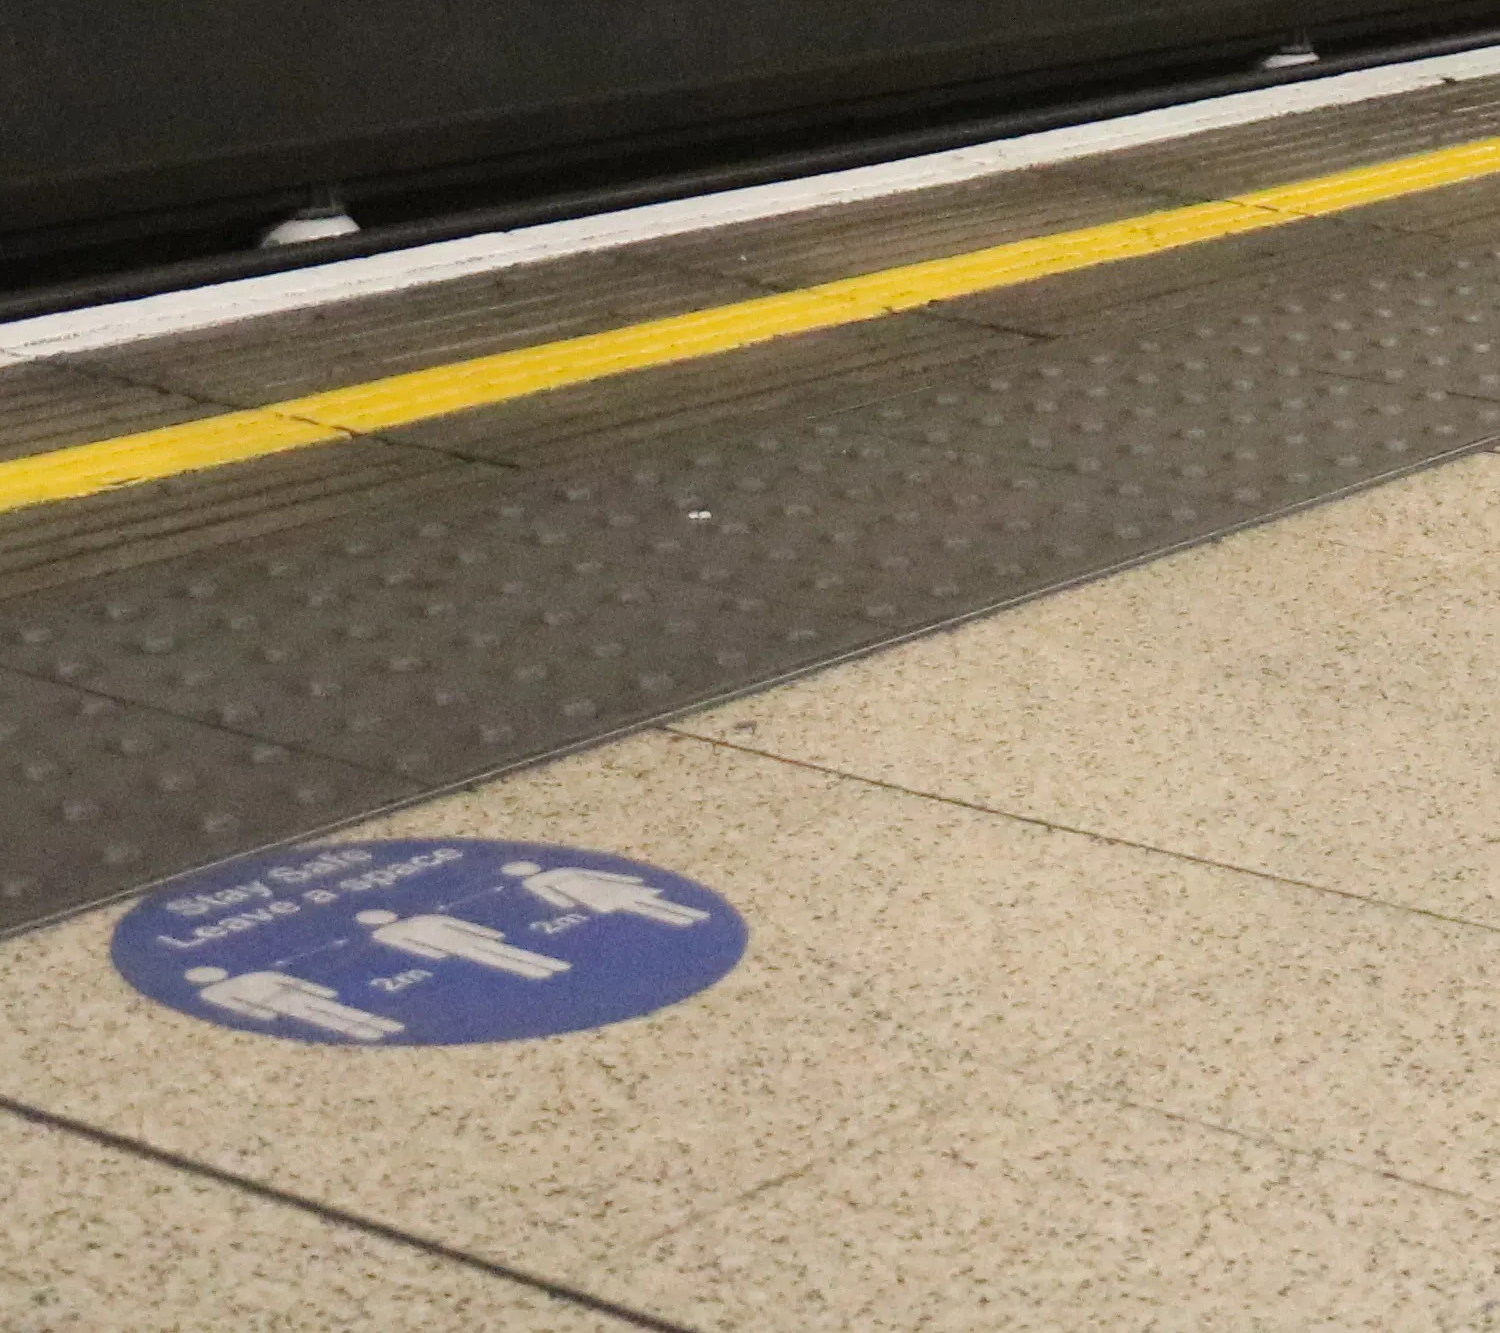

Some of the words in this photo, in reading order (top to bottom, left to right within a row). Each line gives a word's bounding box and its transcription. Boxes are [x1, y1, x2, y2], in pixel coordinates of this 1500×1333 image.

[155, 899, 302, 948] Leave
[303, 888, 339, 905] a
[339, 847, 465, 892] space
[166, 880, 273, 917] Stay
[267, 848, 373, 884] safe
[529, 912, 592, 935] 2m
[369, 967, 435, 993] 2m
